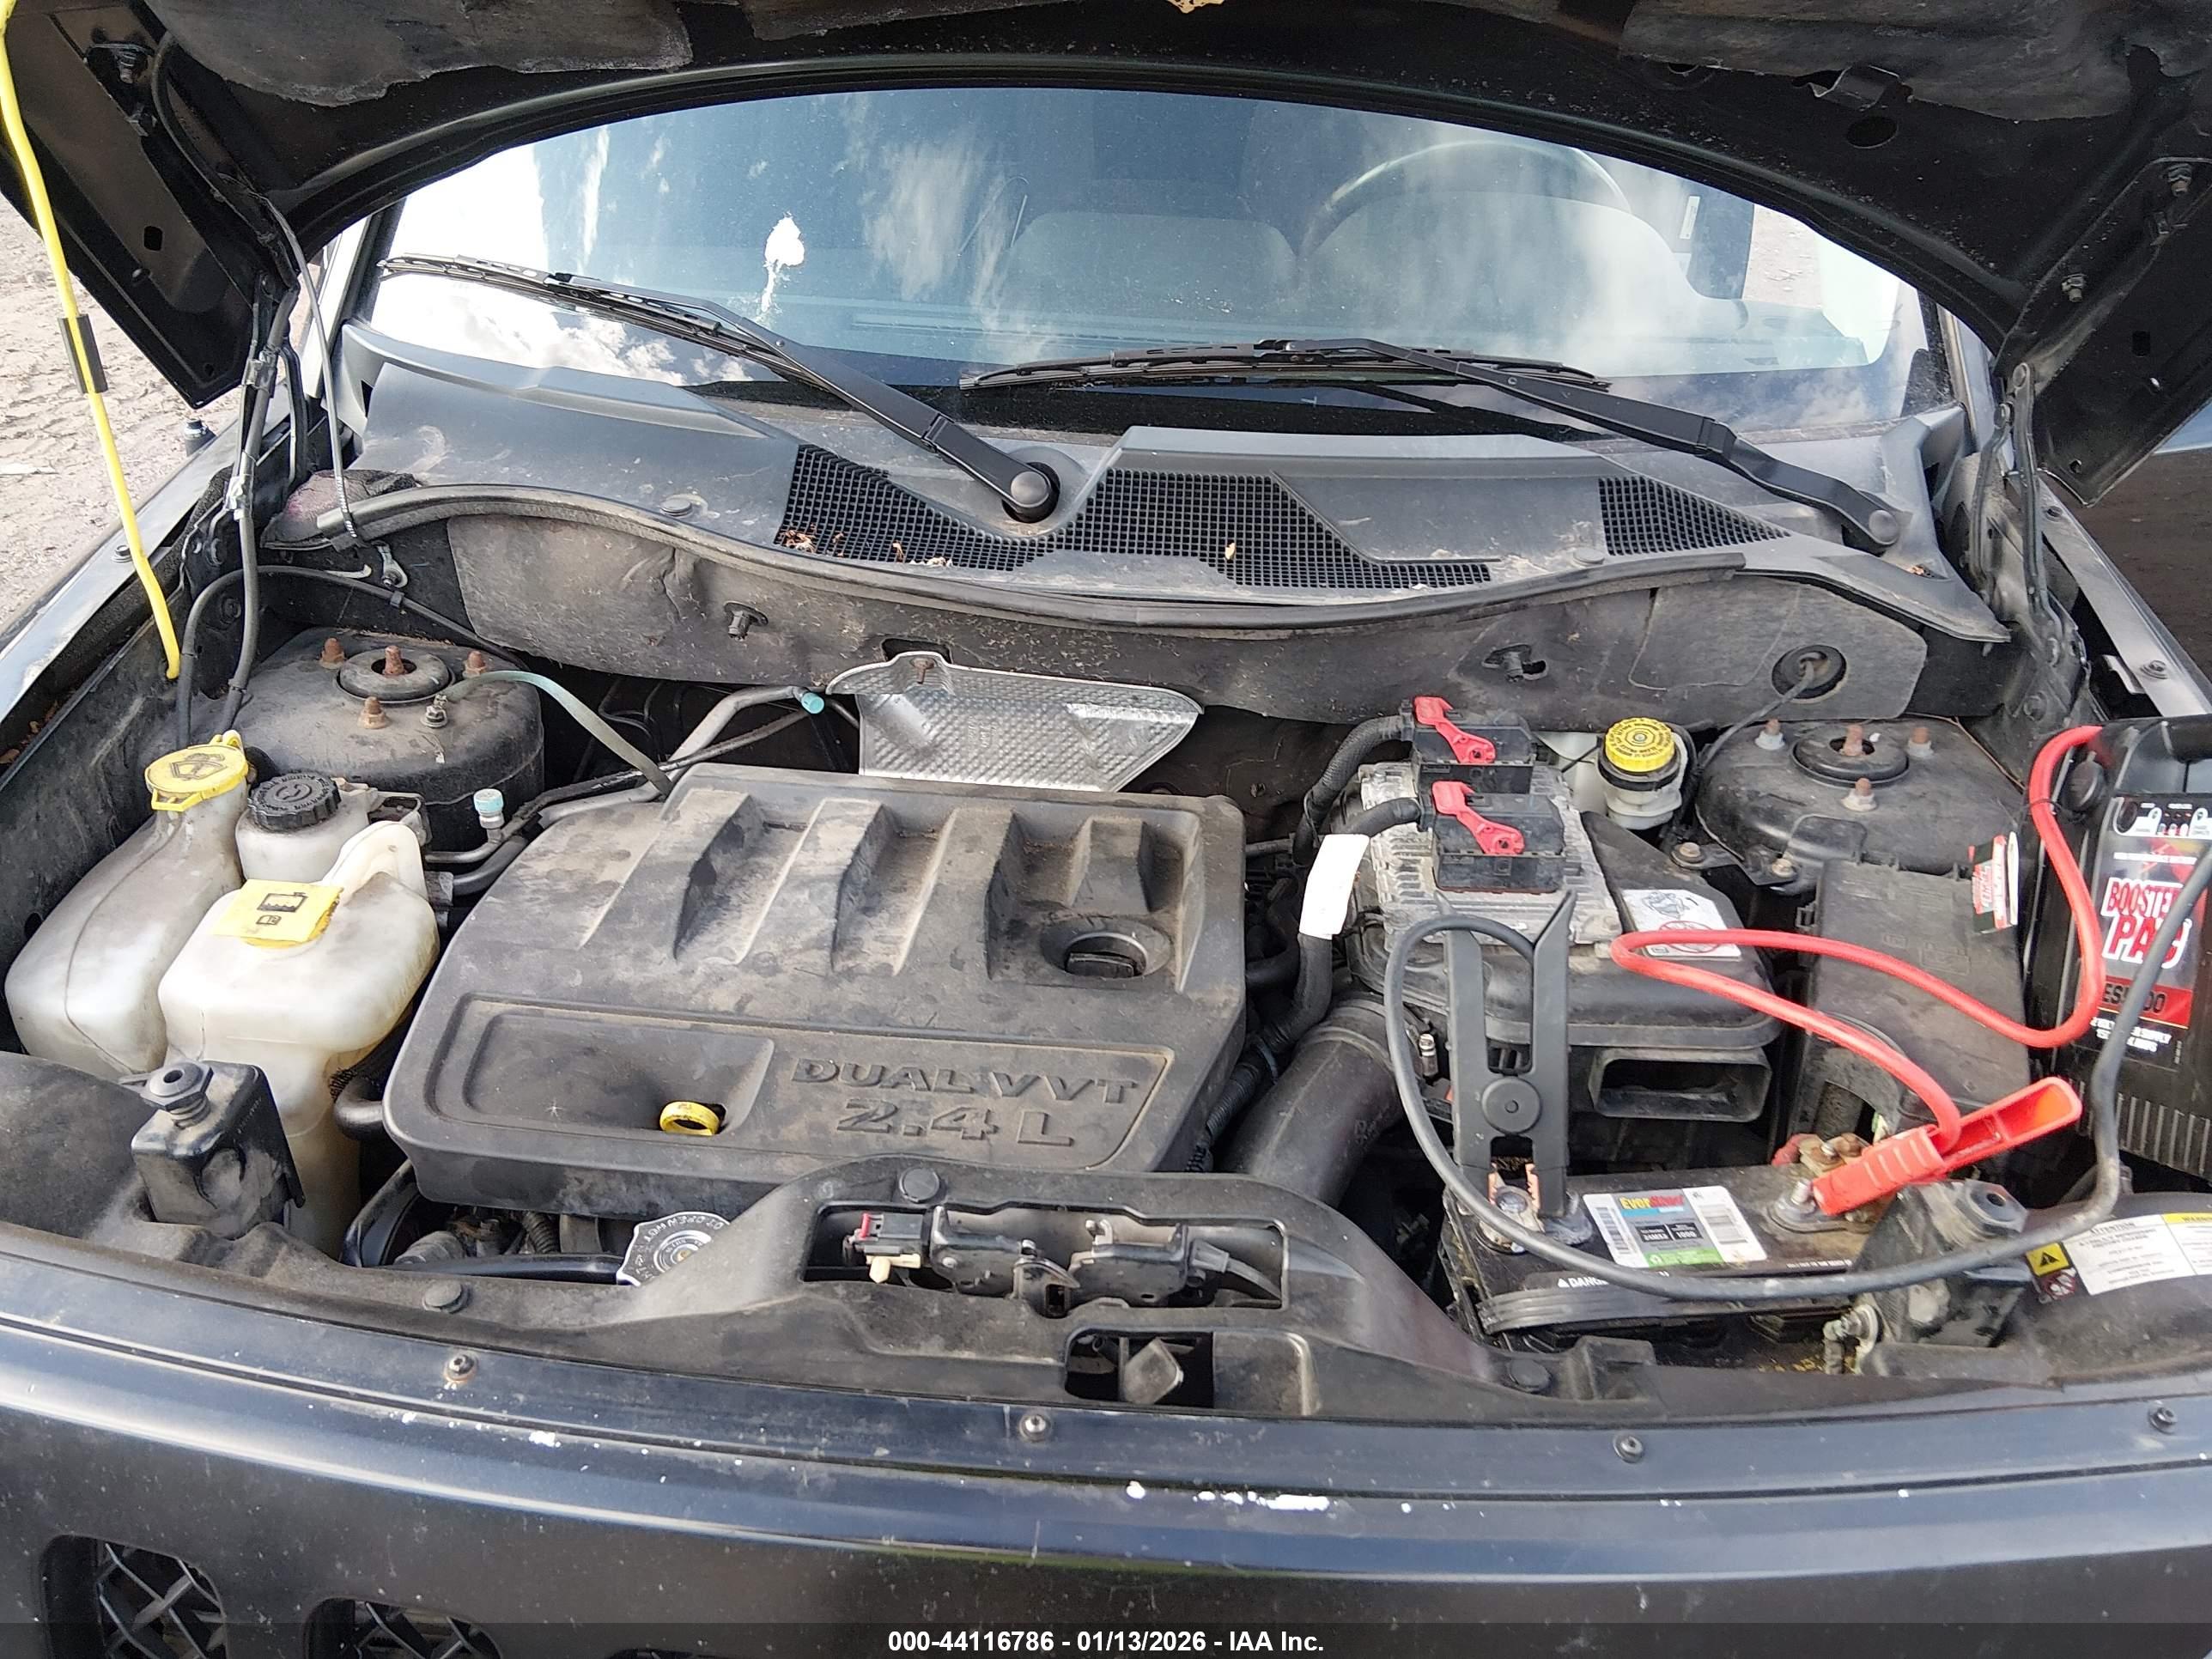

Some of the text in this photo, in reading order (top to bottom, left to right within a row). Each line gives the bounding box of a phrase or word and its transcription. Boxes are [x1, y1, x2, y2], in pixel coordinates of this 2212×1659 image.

[2101, 982, 2166, 1014] ES00
[792, 1058, 1139, 1104] DUAL VVT
[836, 1097, 1075, 1147] 2.4 L
